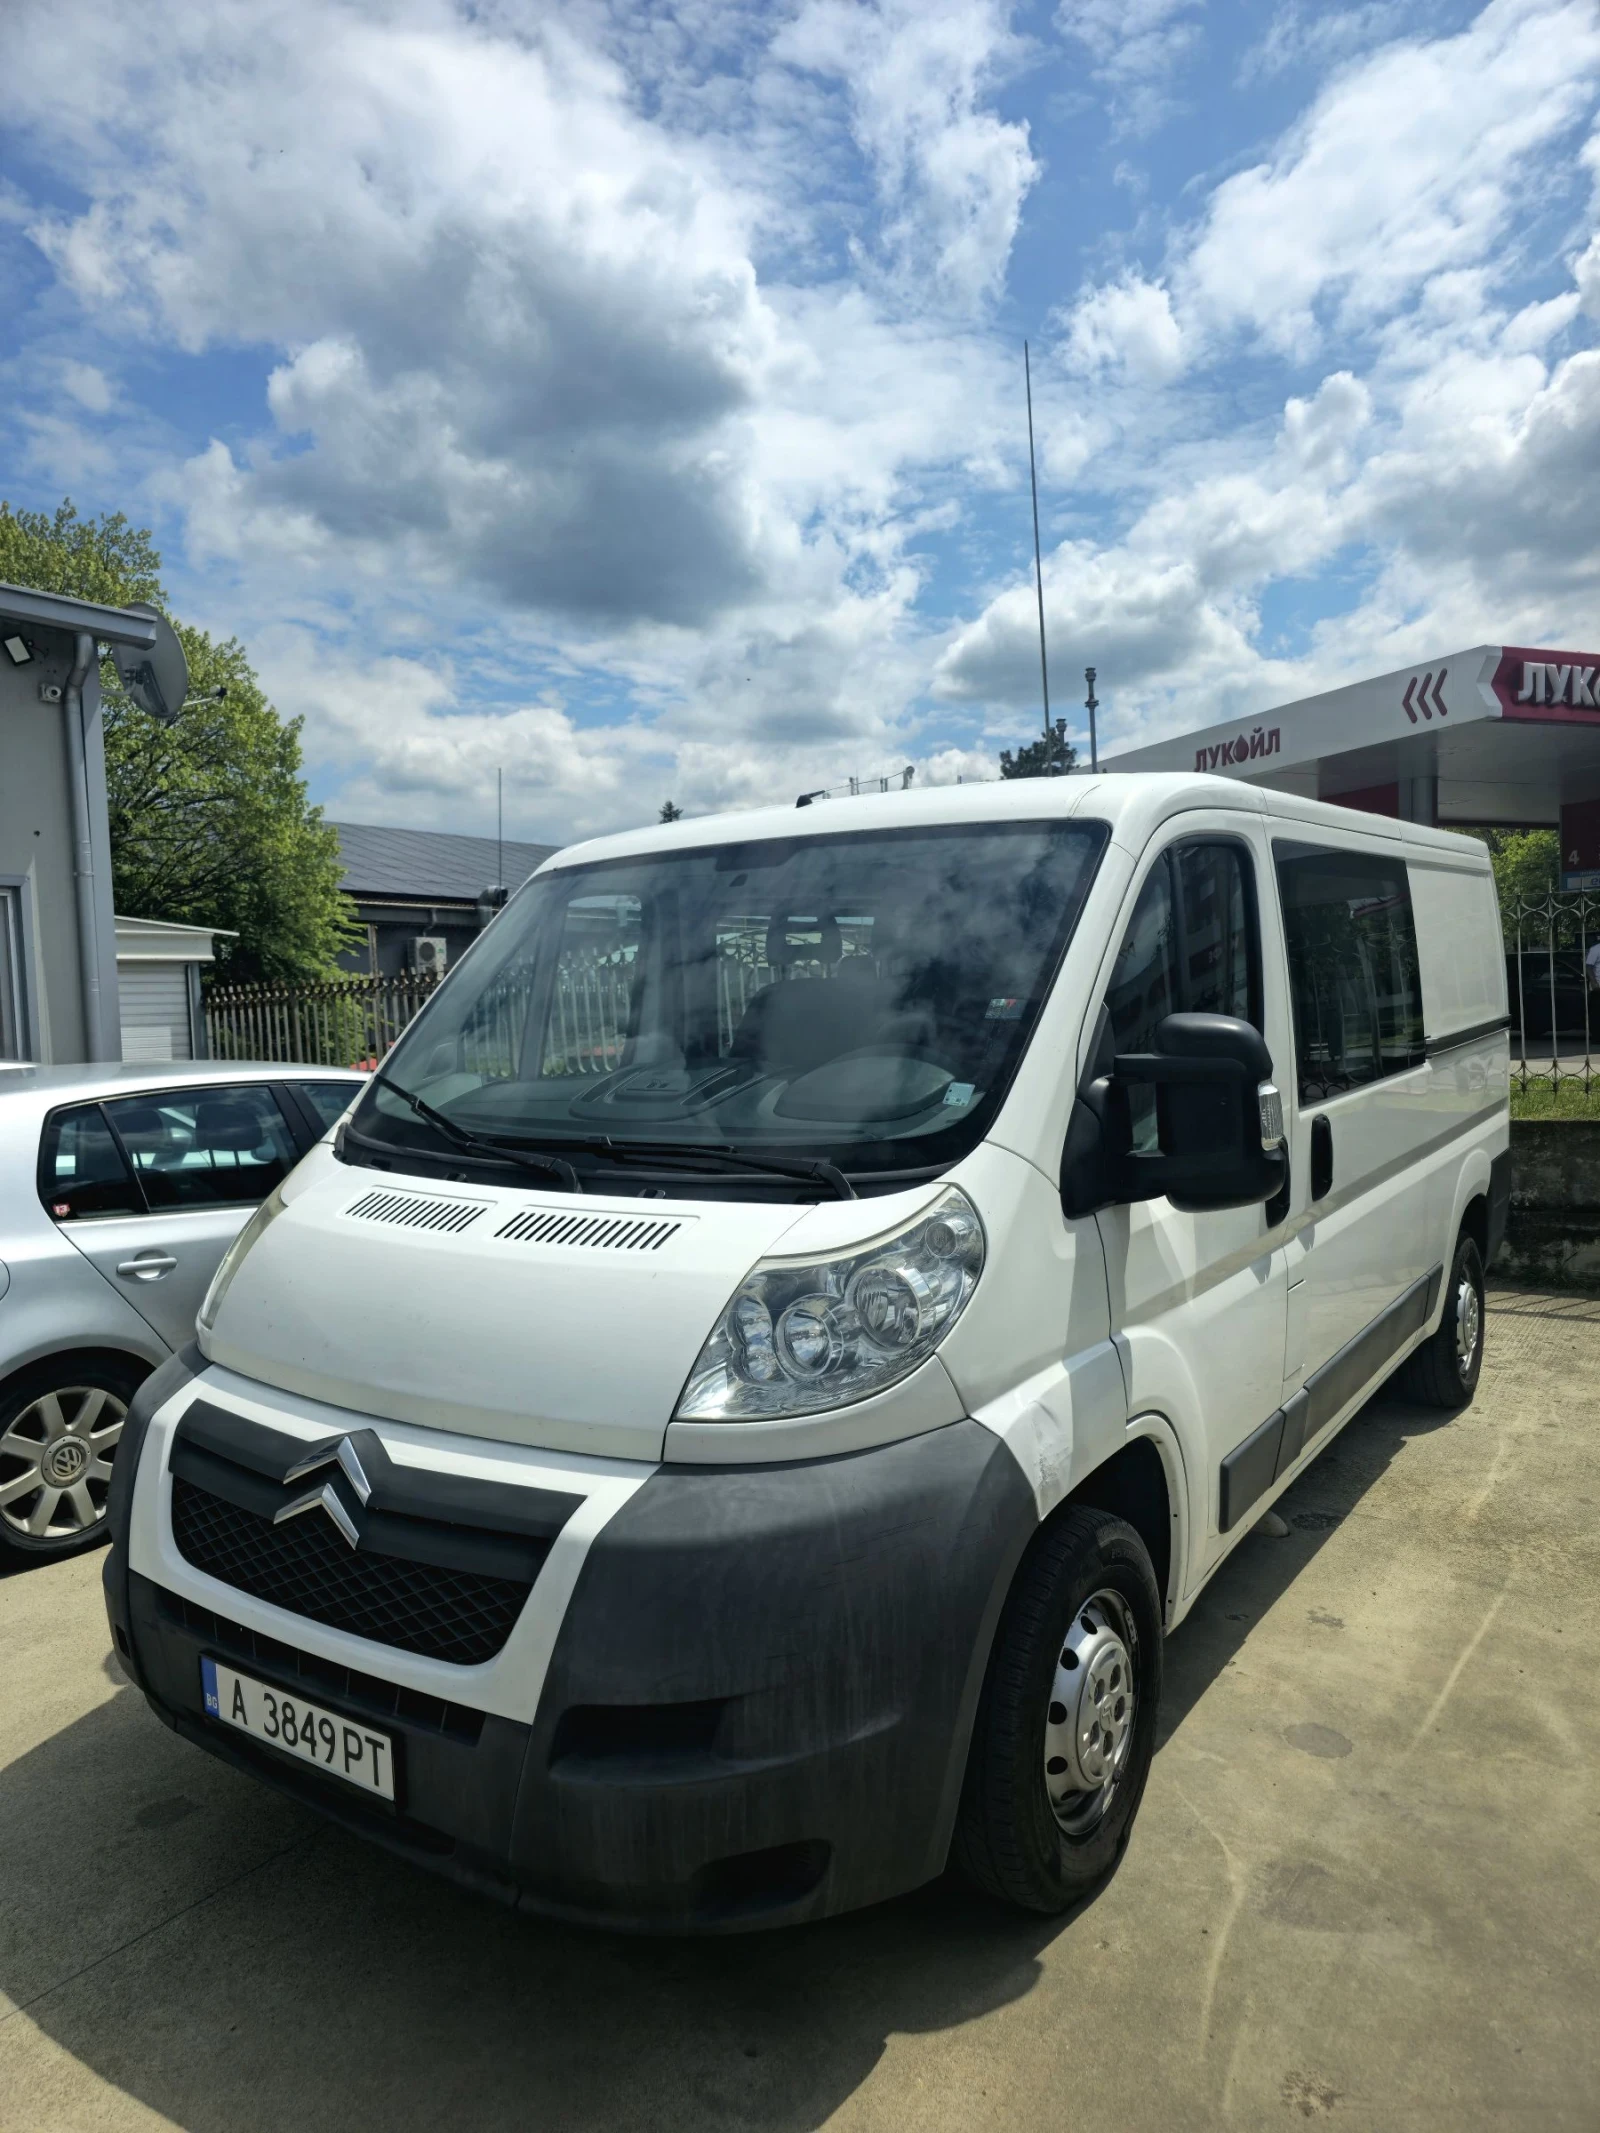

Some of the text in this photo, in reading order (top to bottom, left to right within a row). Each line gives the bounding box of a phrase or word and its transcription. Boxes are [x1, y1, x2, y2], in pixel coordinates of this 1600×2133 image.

[1517, 661, 1600, 707] ЛУК
[1193, 726, 1281, 773] ЛУКОЙЛ
[1568, 849, 1580, 865] 4
[206, 1692, 218, 1709] BG
[231, 1678, 385, 1787] A 3849PT
